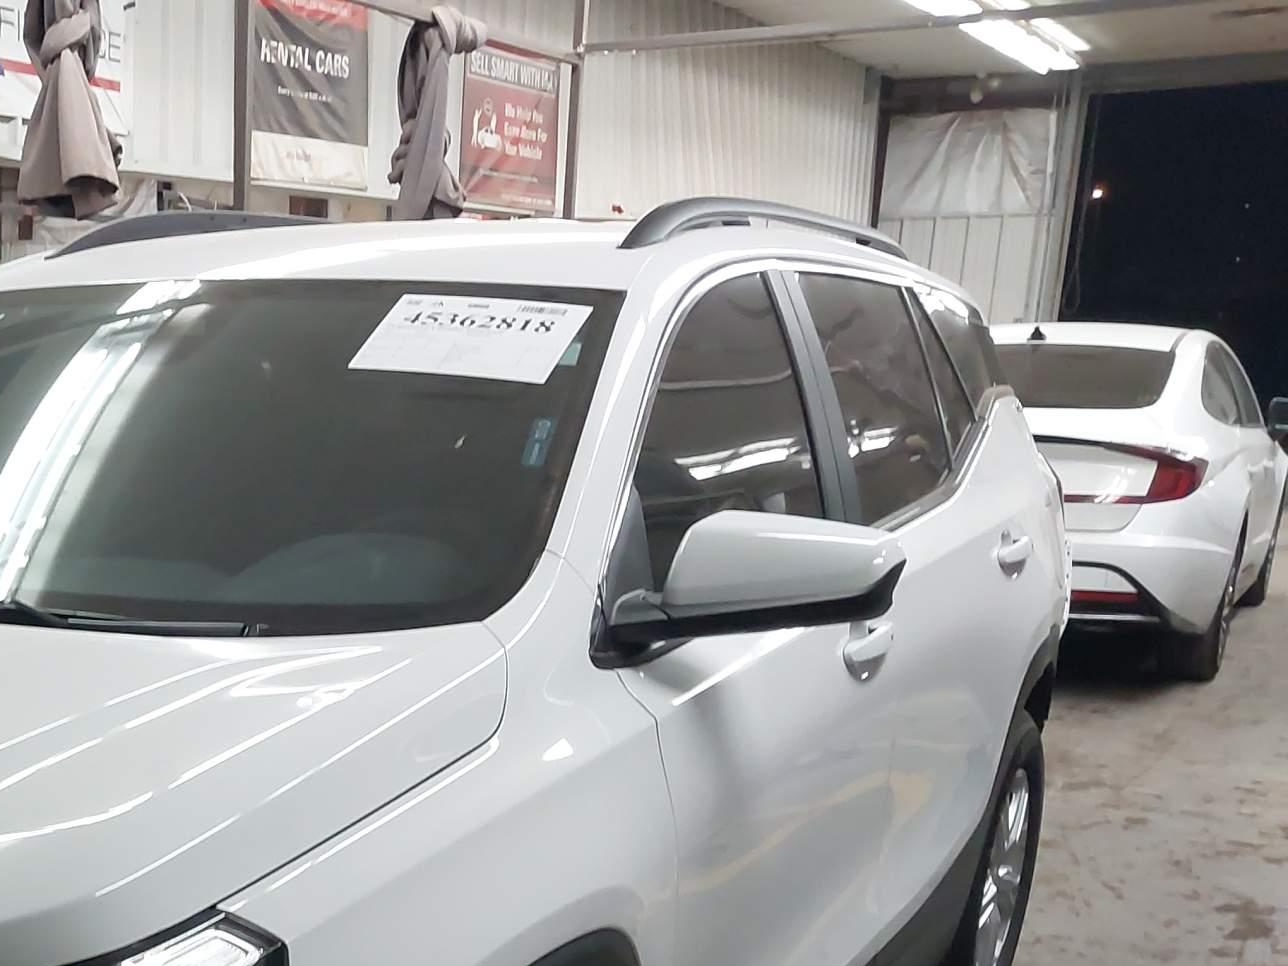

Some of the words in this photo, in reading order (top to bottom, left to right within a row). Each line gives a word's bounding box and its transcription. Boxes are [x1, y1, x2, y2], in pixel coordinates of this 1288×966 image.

[260, 37, 312, 72] RENTAL
[315, 50, 350, 79] CARS
[471, 50, 490, 76] SELL
[491, 56, 519, 83] SMART
[520, 63, 541, 89] WITH
[403, 311, 556, 333] 45362818
